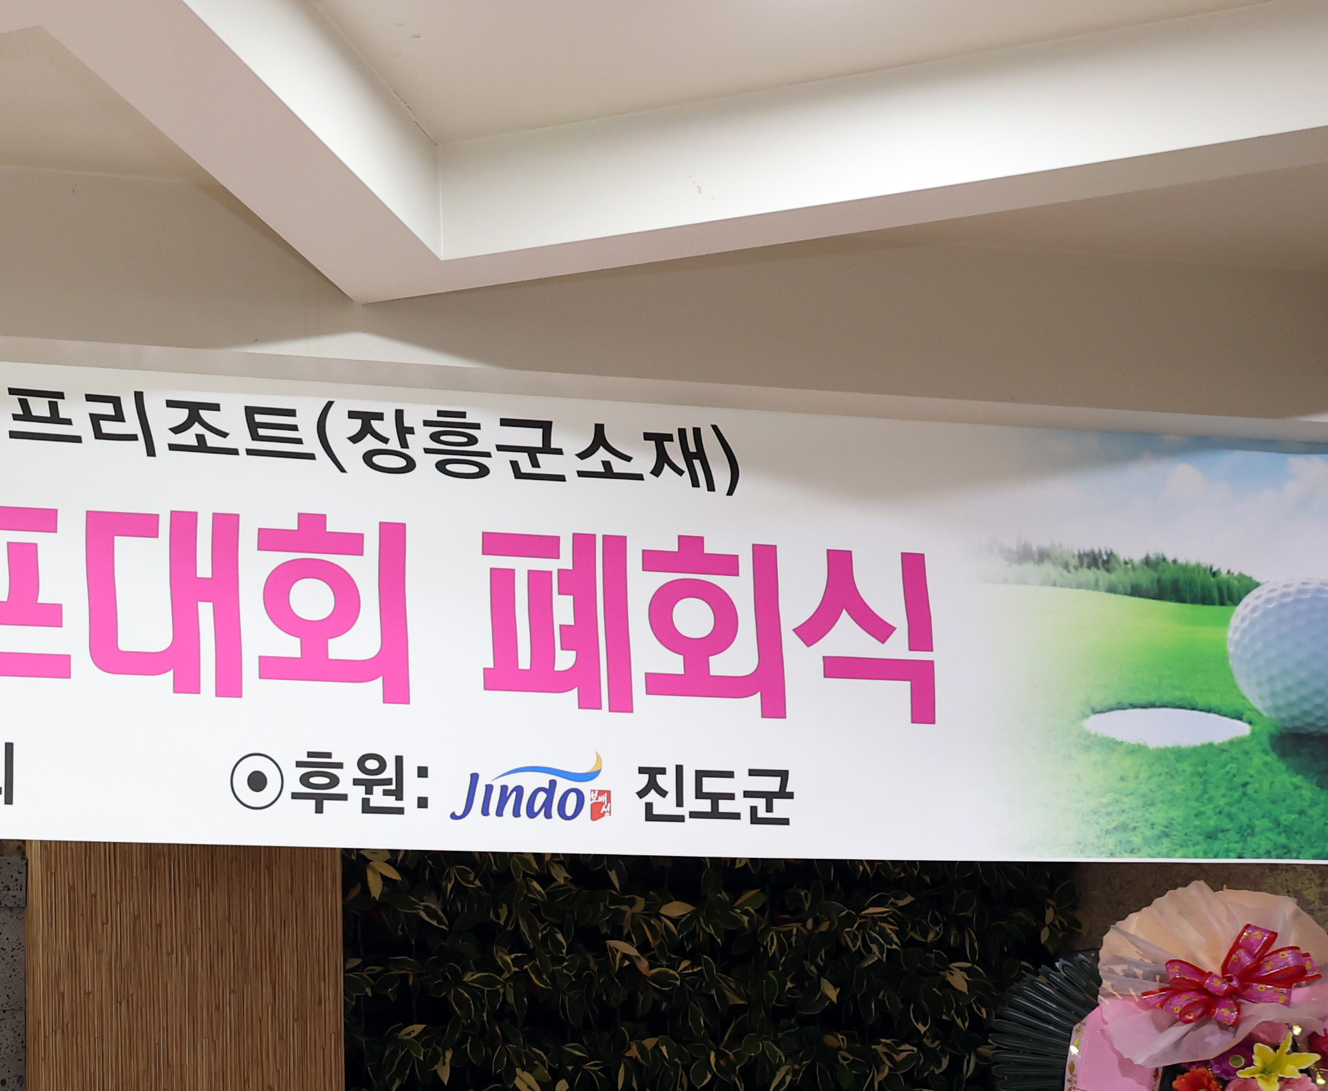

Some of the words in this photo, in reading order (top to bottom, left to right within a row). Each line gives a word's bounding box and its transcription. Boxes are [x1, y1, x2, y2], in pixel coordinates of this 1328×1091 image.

[481, 531, 937, 726] 폐회식
[290, 750, 429, 816] 후원:
[449, 771, 586, 822] Jindo
[635, 763, 795, 826] 진도군
